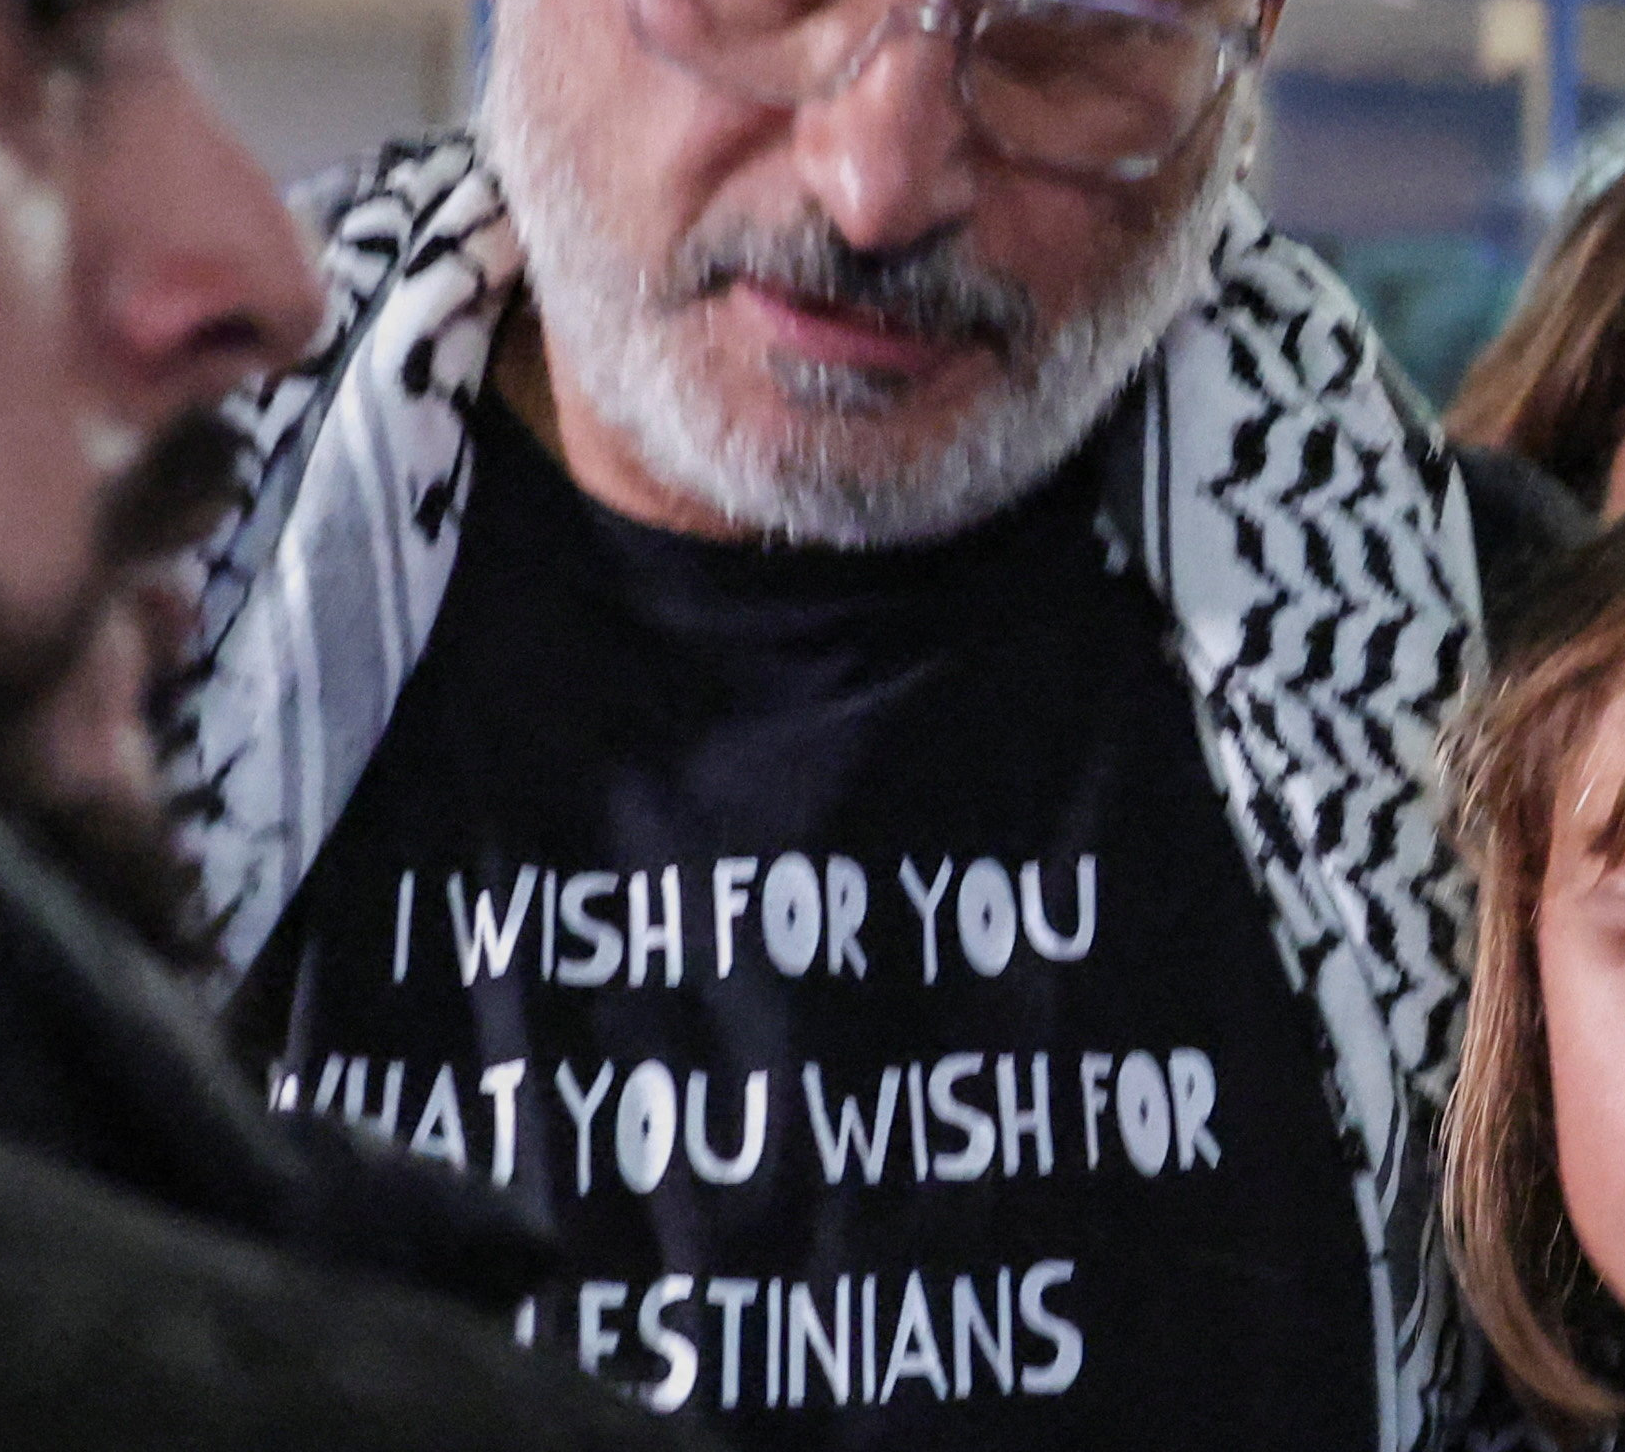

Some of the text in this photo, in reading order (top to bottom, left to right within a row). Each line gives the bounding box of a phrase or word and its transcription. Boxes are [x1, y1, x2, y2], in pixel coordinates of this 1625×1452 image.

[392, 851, 1098, 989] I WISH FOR YOU
[553, 1058, 771, 1198] YOU
[801, 1051, 1056, 1186] WISH
[1078, 1047, 1223, 1176] FOR
